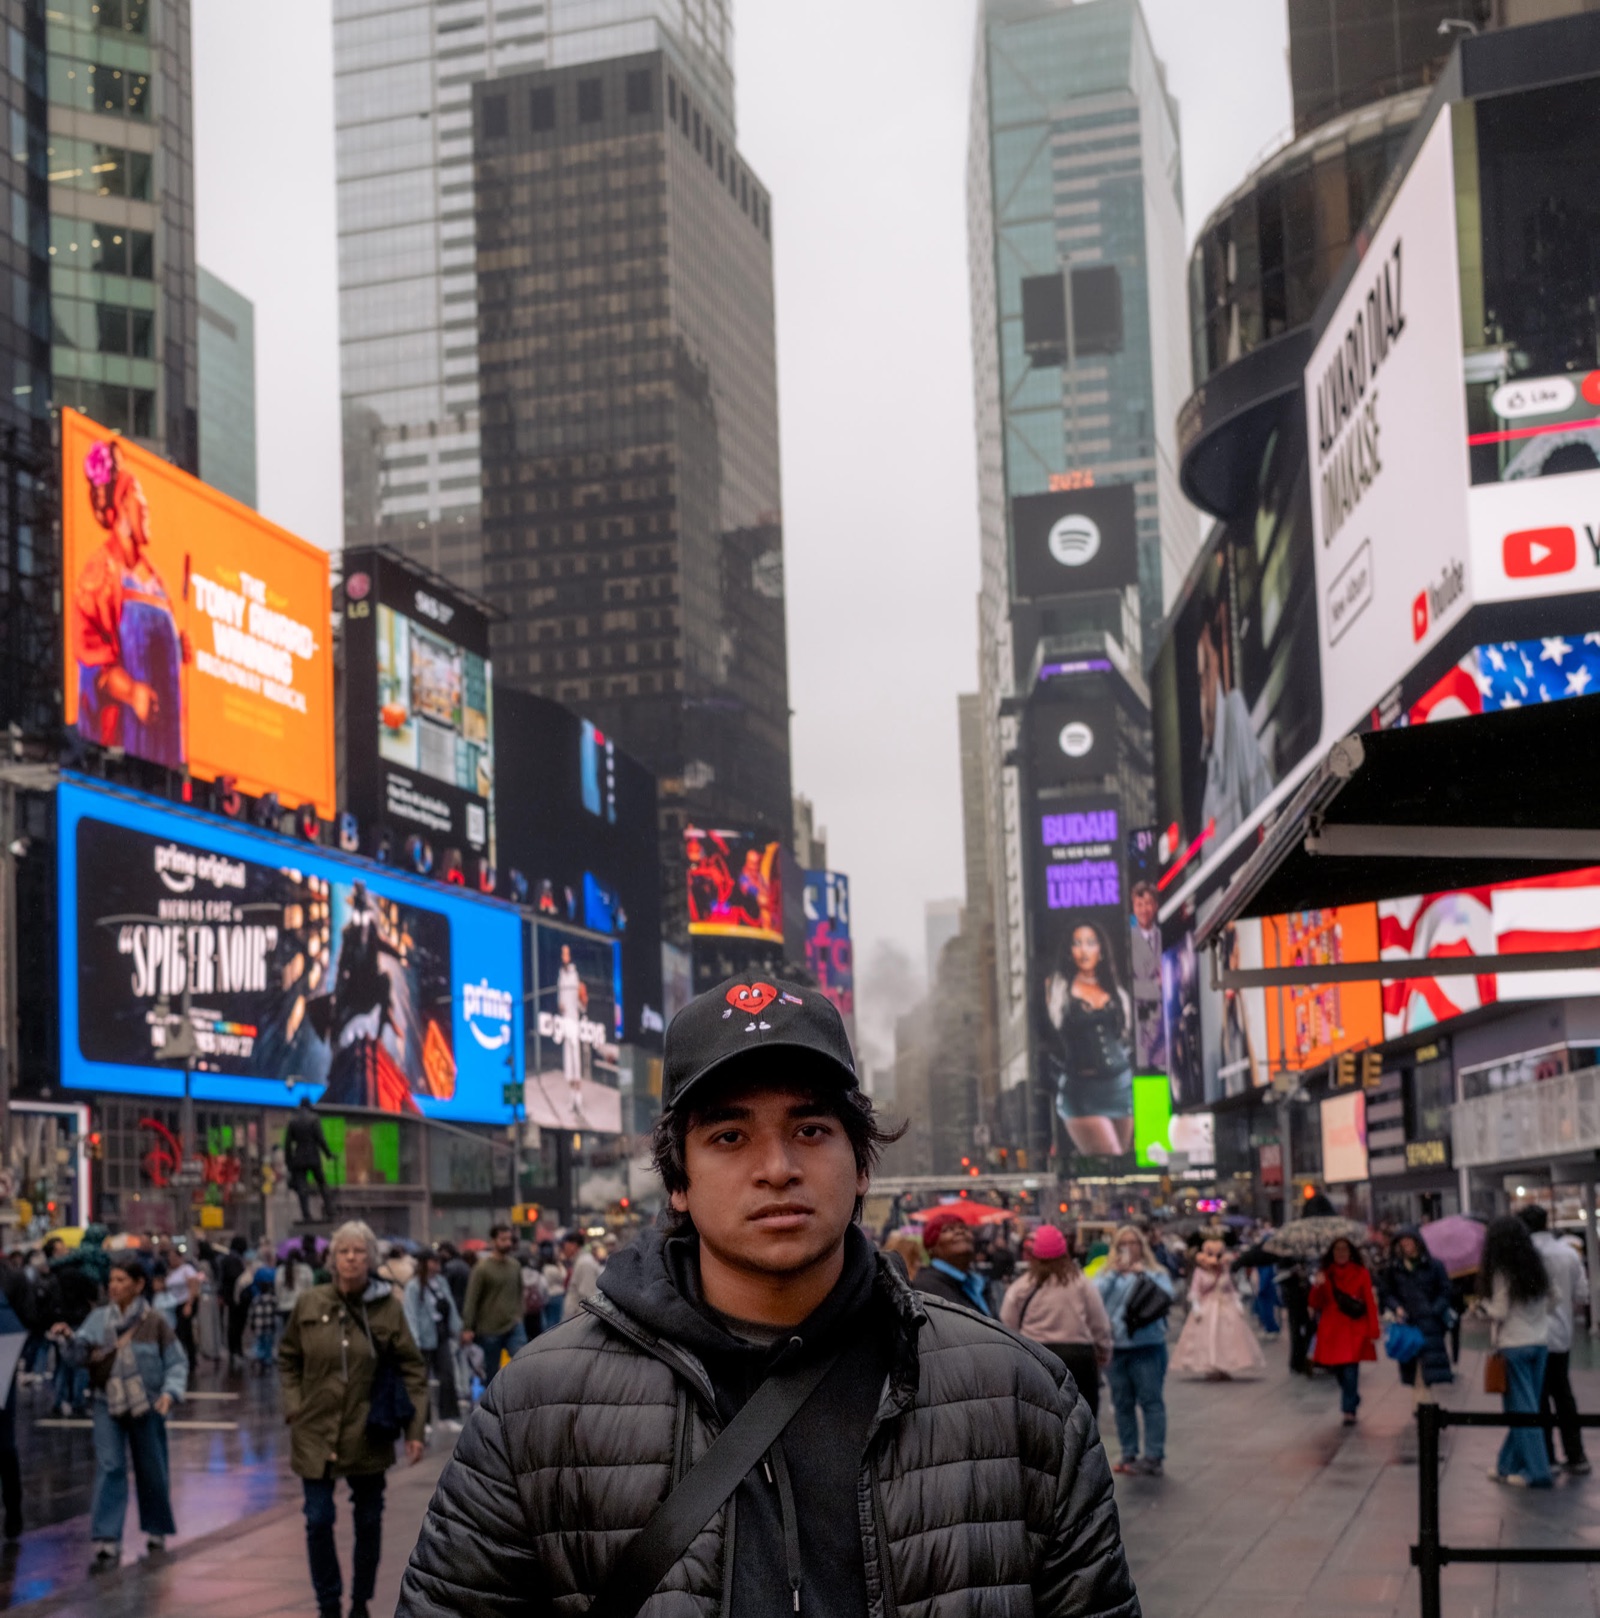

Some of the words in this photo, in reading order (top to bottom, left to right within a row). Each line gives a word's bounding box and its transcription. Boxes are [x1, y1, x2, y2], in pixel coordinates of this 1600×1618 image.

[1530, 389, 1558, 404] Like
[190, 573, 246, 629] TONY
[347, 600, 370, 619] LG
[1428, 557, 1464, 622] YouTube
[1041, 810, 1118, 846] BUDAH
[154, 843, 196, 876] prime
[197, 853, 246, 889] original
[1047, 879, 1120, 909] LUNAR
[463, 977, 513, 1022] prime
